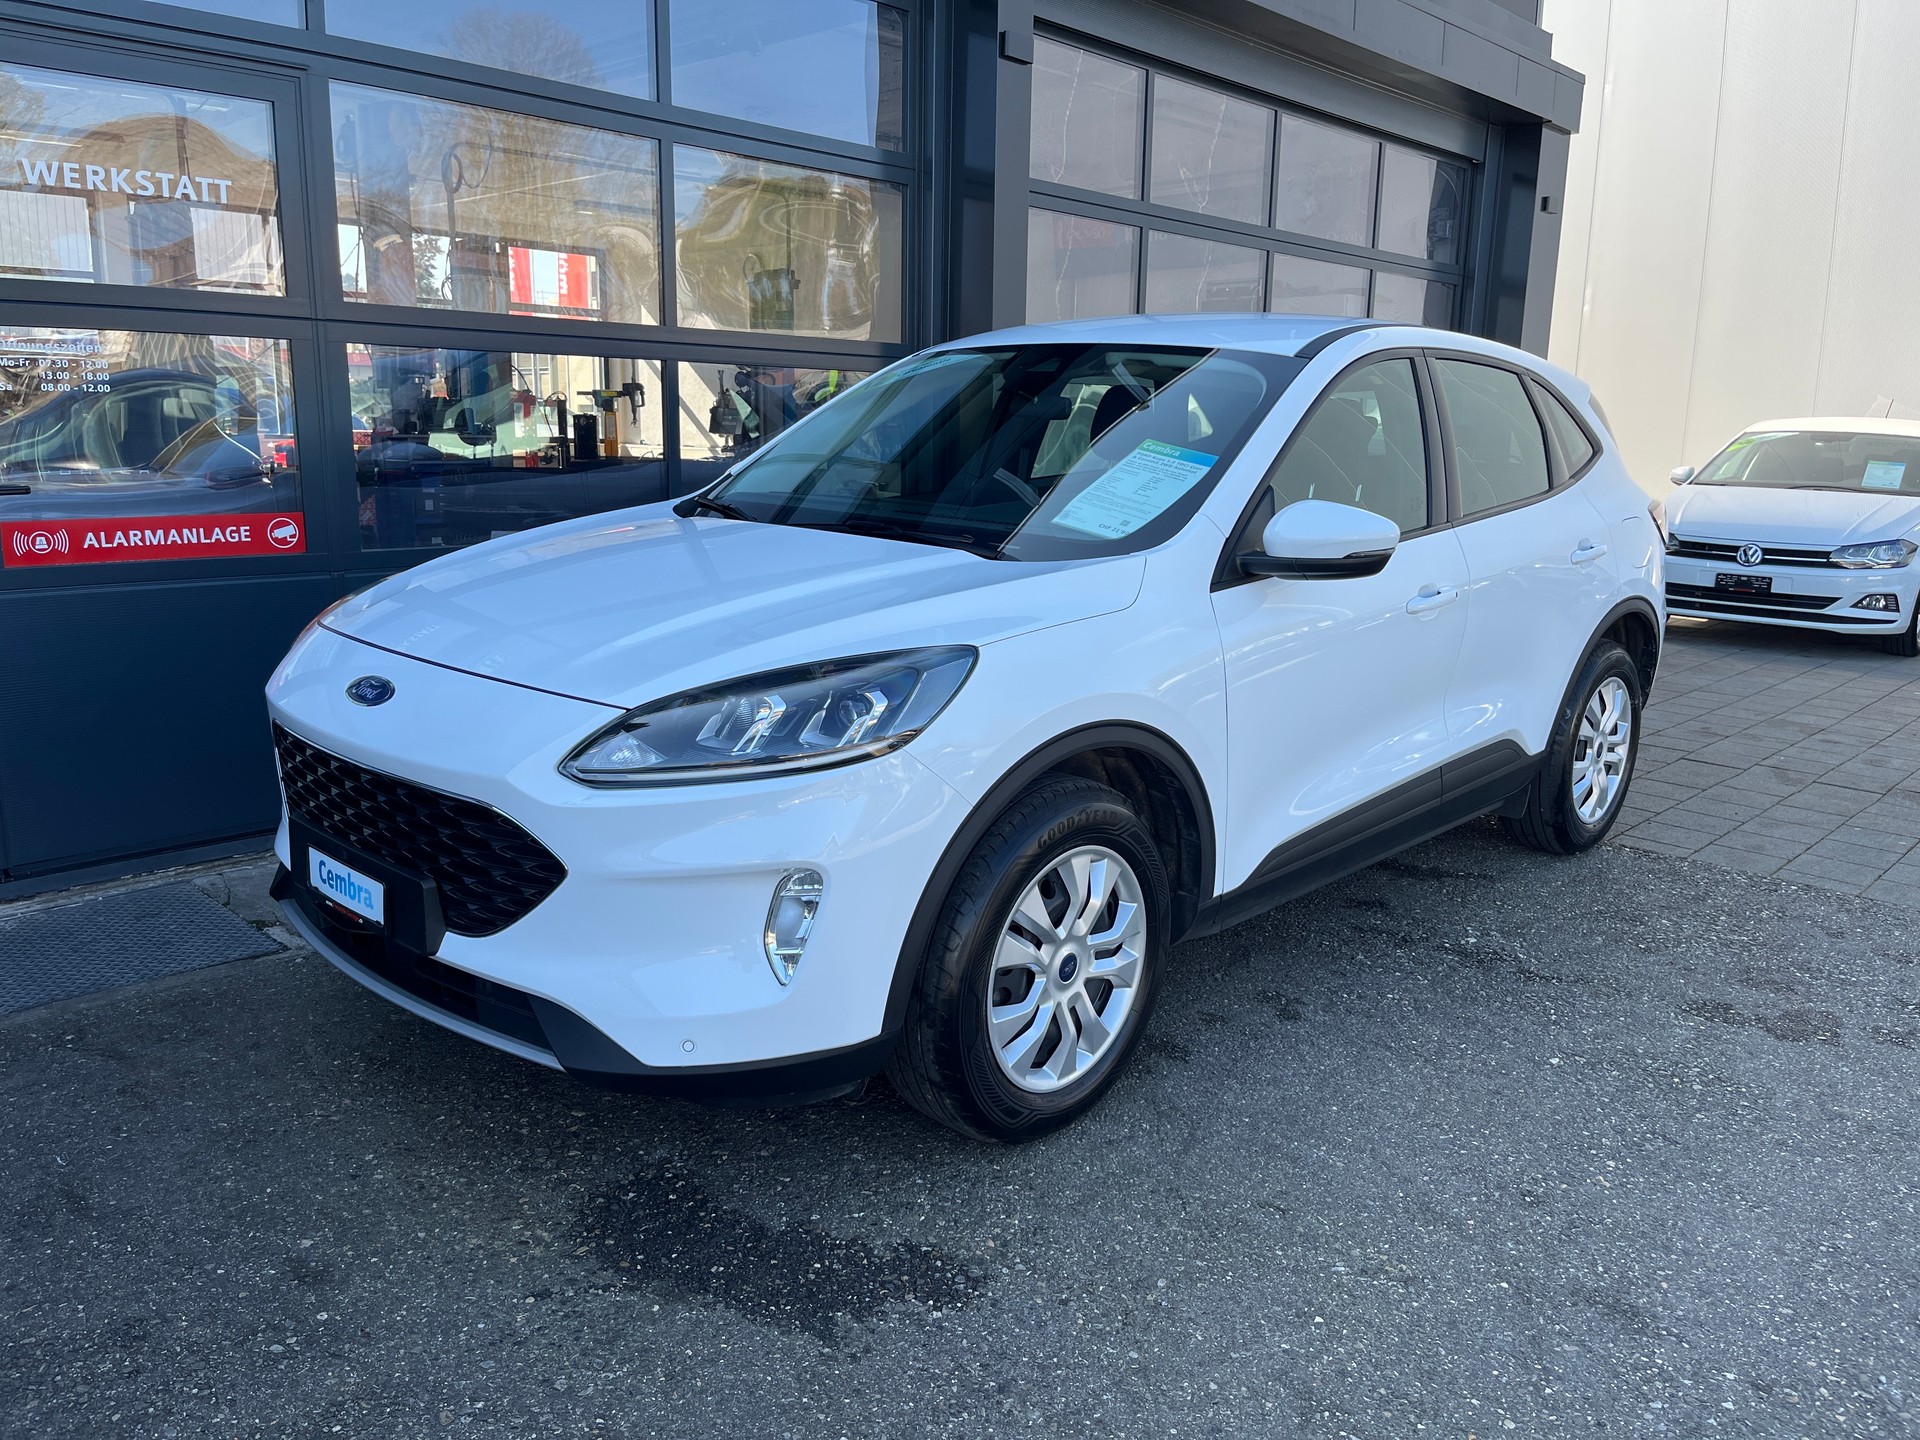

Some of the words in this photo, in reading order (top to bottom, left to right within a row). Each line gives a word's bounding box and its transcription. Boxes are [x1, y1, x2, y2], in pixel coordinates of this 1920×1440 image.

[22, 158, 232, 204] WERKSTATT
[0, 358, 31, 367] Mo-Fr
[39, 360, 69, 368] 07.30
[80, 360, 109, 369] 12.00
[41, 371, 70, 380] 13.00
[81, 372, 110, 381] 18.00
[0, 382, 13, 391] Sa
[40, 383, 71, 392] 08.00
[82, 383, 111, 393] 12.00
[1143, 442, 1181, 457] Cembra
[83, 526, 251, 549] ALARMANLAGE
[352, 679, 383, 699] Ford
[1036, 808, 1119, 850] GOODYEAR
[318, 859, 374, 910] Cembra
